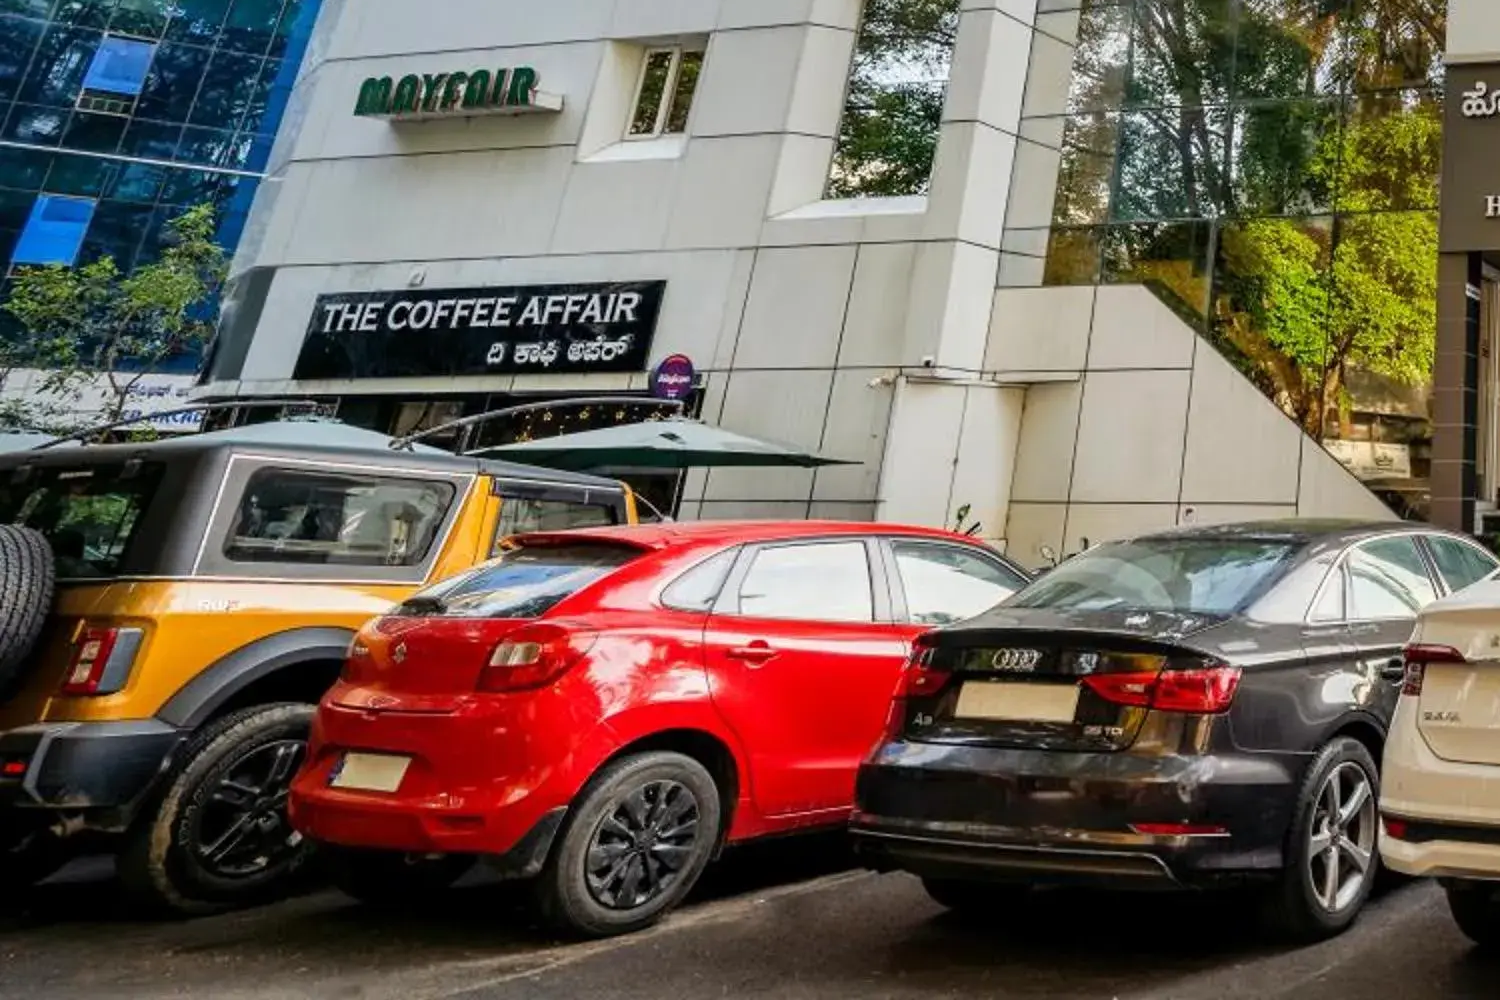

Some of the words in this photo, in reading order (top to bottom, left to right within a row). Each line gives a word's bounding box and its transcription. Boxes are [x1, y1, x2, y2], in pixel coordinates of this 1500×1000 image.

[354, 67, 538, 116] MAYFAIR
[323, 302, 382, 333] THE
[387, 297, 517, 331] COFFEE
[517, 292, 642, 326] AFFAIR
